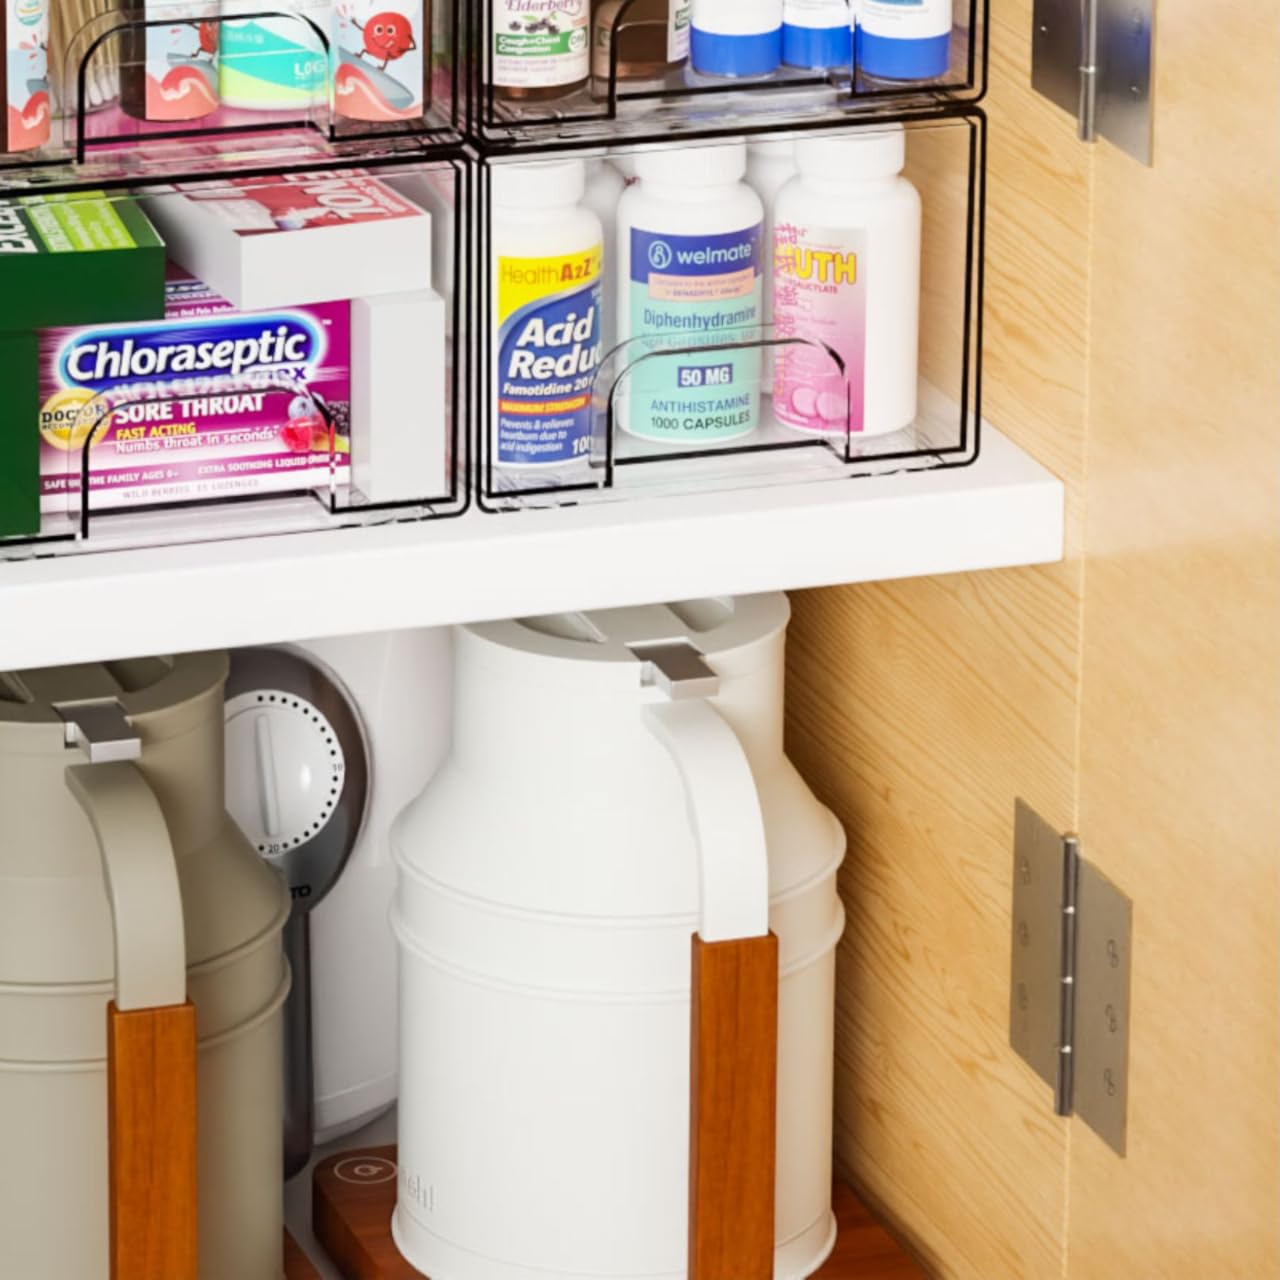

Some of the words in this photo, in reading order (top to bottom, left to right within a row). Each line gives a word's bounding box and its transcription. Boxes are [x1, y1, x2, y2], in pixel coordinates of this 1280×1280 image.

[676, 243, 751, 264] welmate
[516, 306, 595, 347] Acid
[67, 325, 307, 381] Chloraseptic
[681, 368, 702, 386] 50
[706, 367, 731, 385] MG
[503, 380, 572, 397] Famotidine
[114, 399, 173, 424] SORE
[179, 393, 266, 419] THROAT
[651, 393, 751, 413] ANTIHISTAMINE
[651, 417, 679, 430] 1000
[683, 410, 751, 430] CAPSULES
[116, 426, 146, 440] FAST
[150, 422, 196, 438] ACTING
[115, 437, 160, 454] Numbs
[164, 433, 202, 449] throat
[207, 431, 221, 445] in
[45, 478, 66, 490] SAFE
[108, 472, 140, 484] FAMILY
